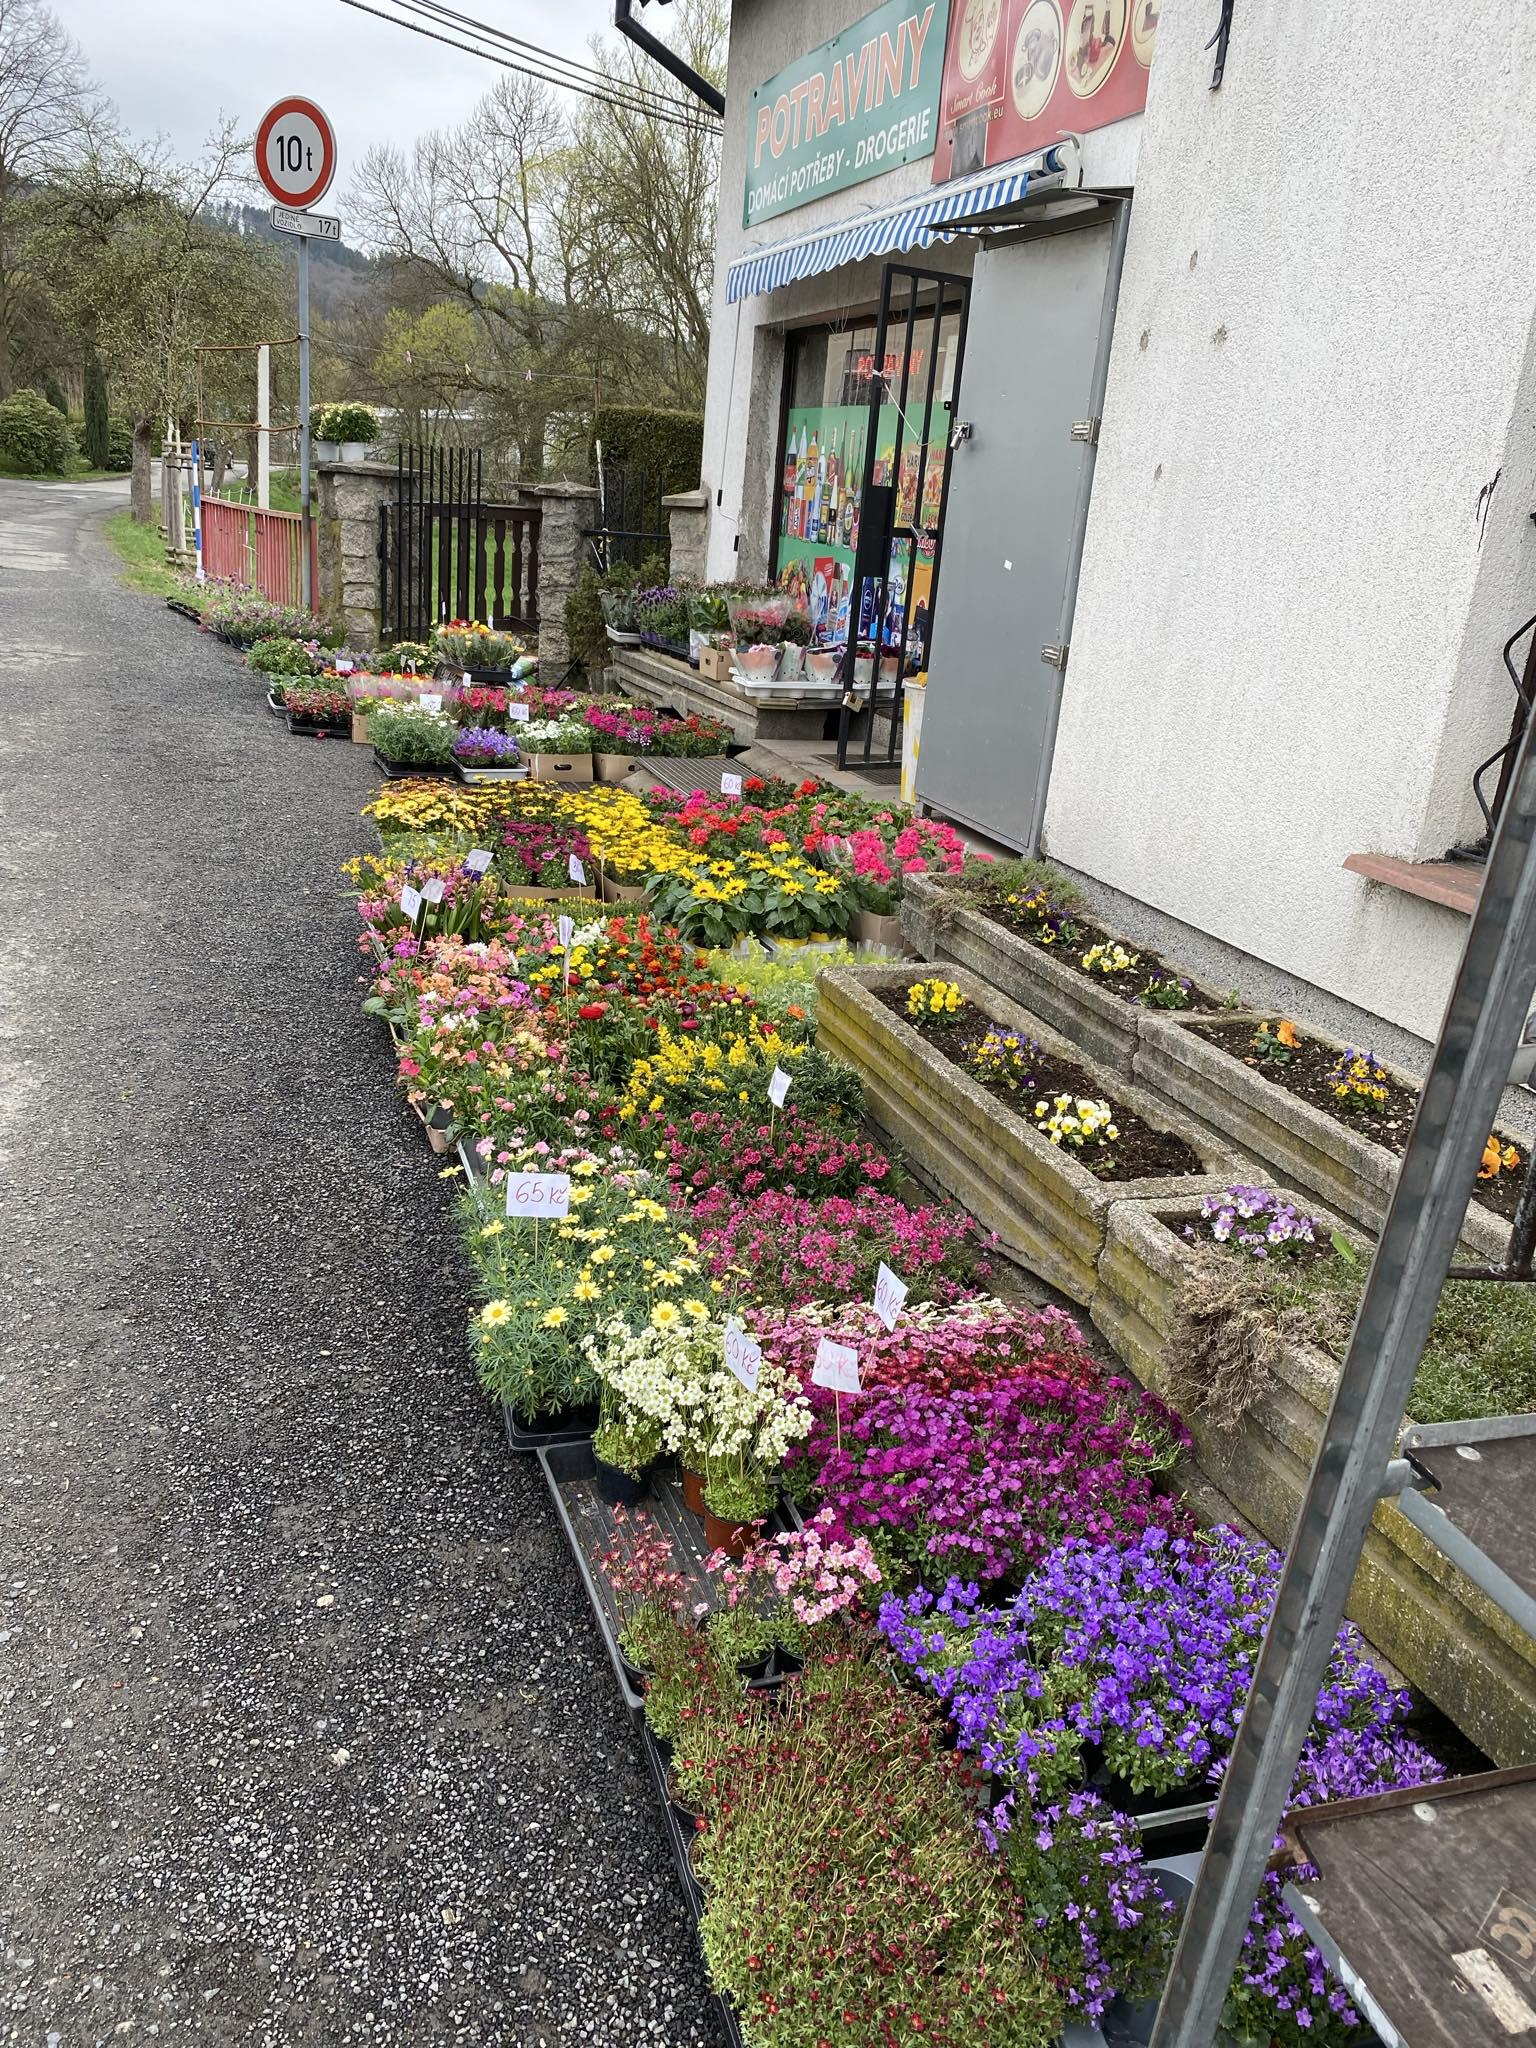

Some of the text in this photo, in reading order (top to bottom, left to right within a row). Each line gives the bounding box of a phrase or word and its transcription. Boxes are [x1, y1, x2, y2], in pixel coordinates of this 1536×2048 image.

[754, 3, 936, 169] POTRAVINY
[748, 167, 789, 214] DOMÁCÍ
[790, 148, 846, 196] POTŘEBY
[855, 107, 932, 169] DROGERIE
[515, 1180, 545, 1204] 65
